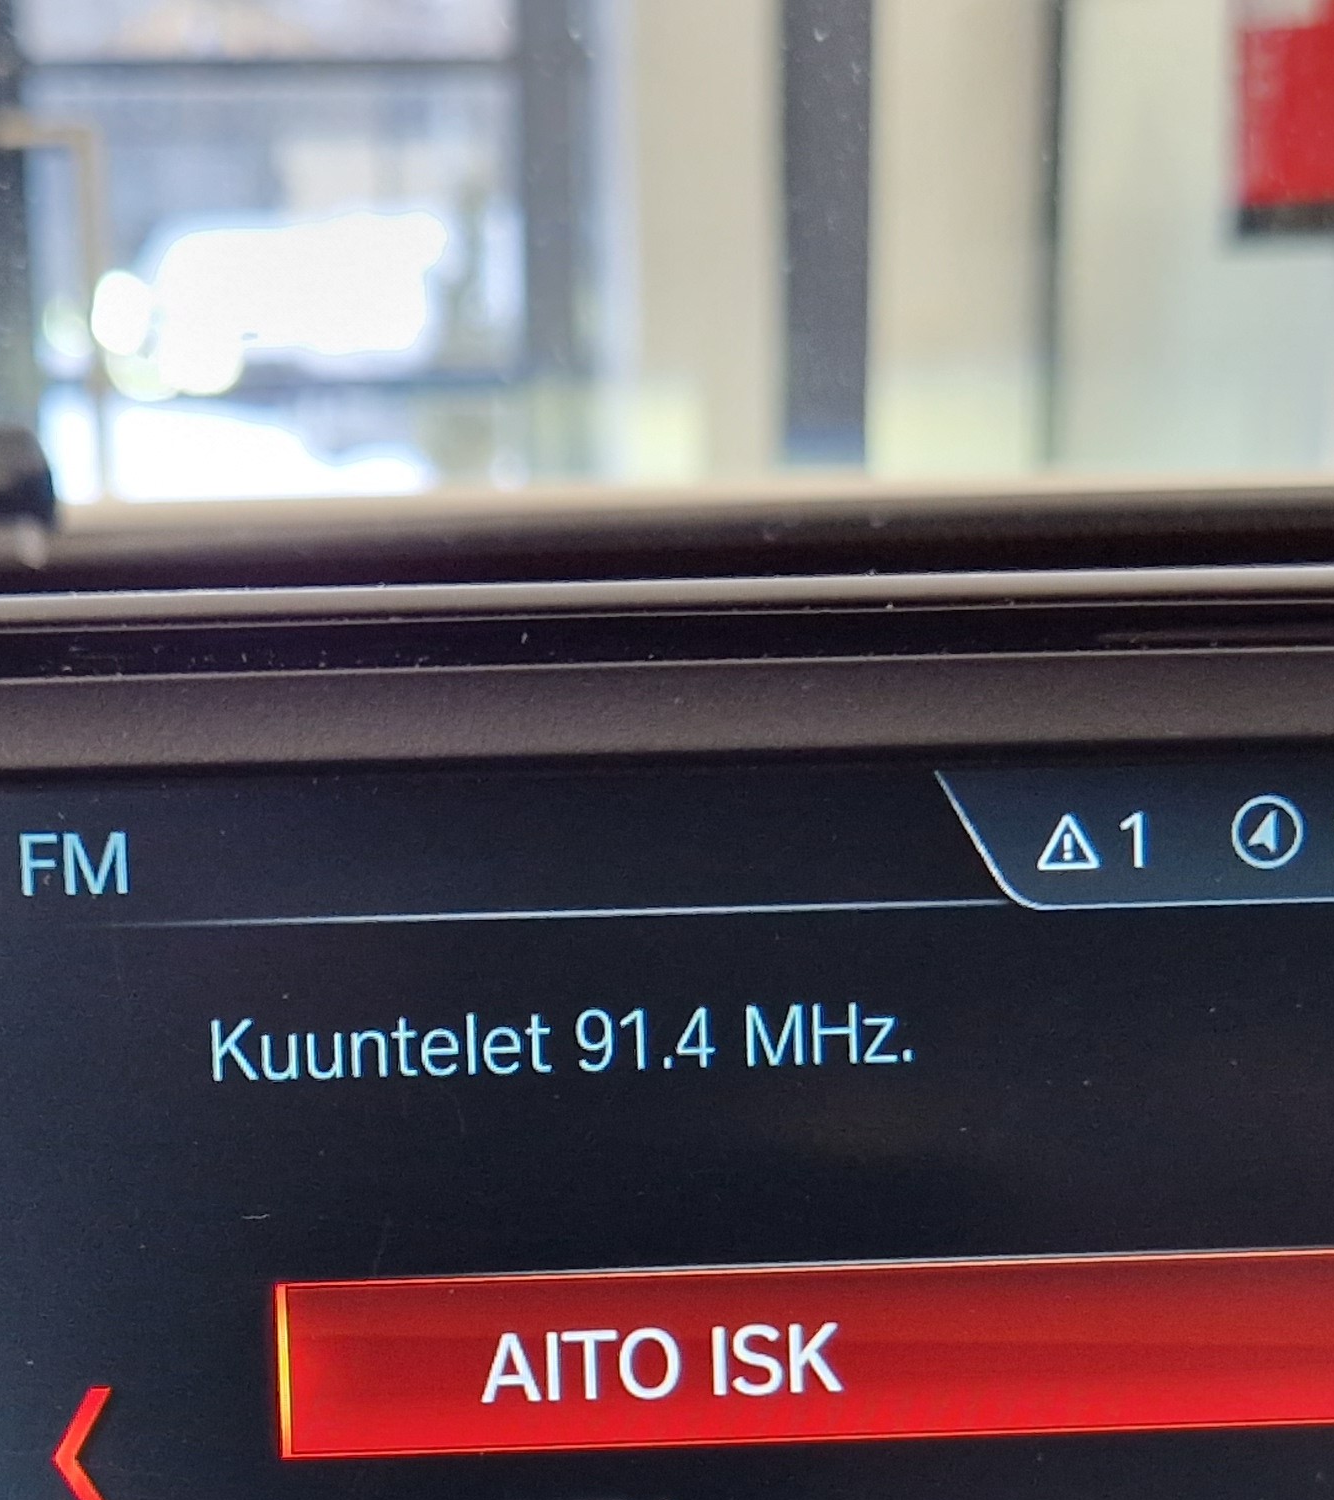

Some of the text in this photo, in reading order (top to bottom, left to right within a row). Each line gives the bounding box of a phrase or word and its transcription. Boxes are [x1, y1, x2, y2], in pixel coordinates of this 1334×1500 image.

[19, 831, 129, 897] FM
[1119, 811, 1144, 869] 1
[210, 1002, 913, 1082] Kuuntelet 91.4 MHz.
[481, 1322, 844, 1404] AITO ISK
